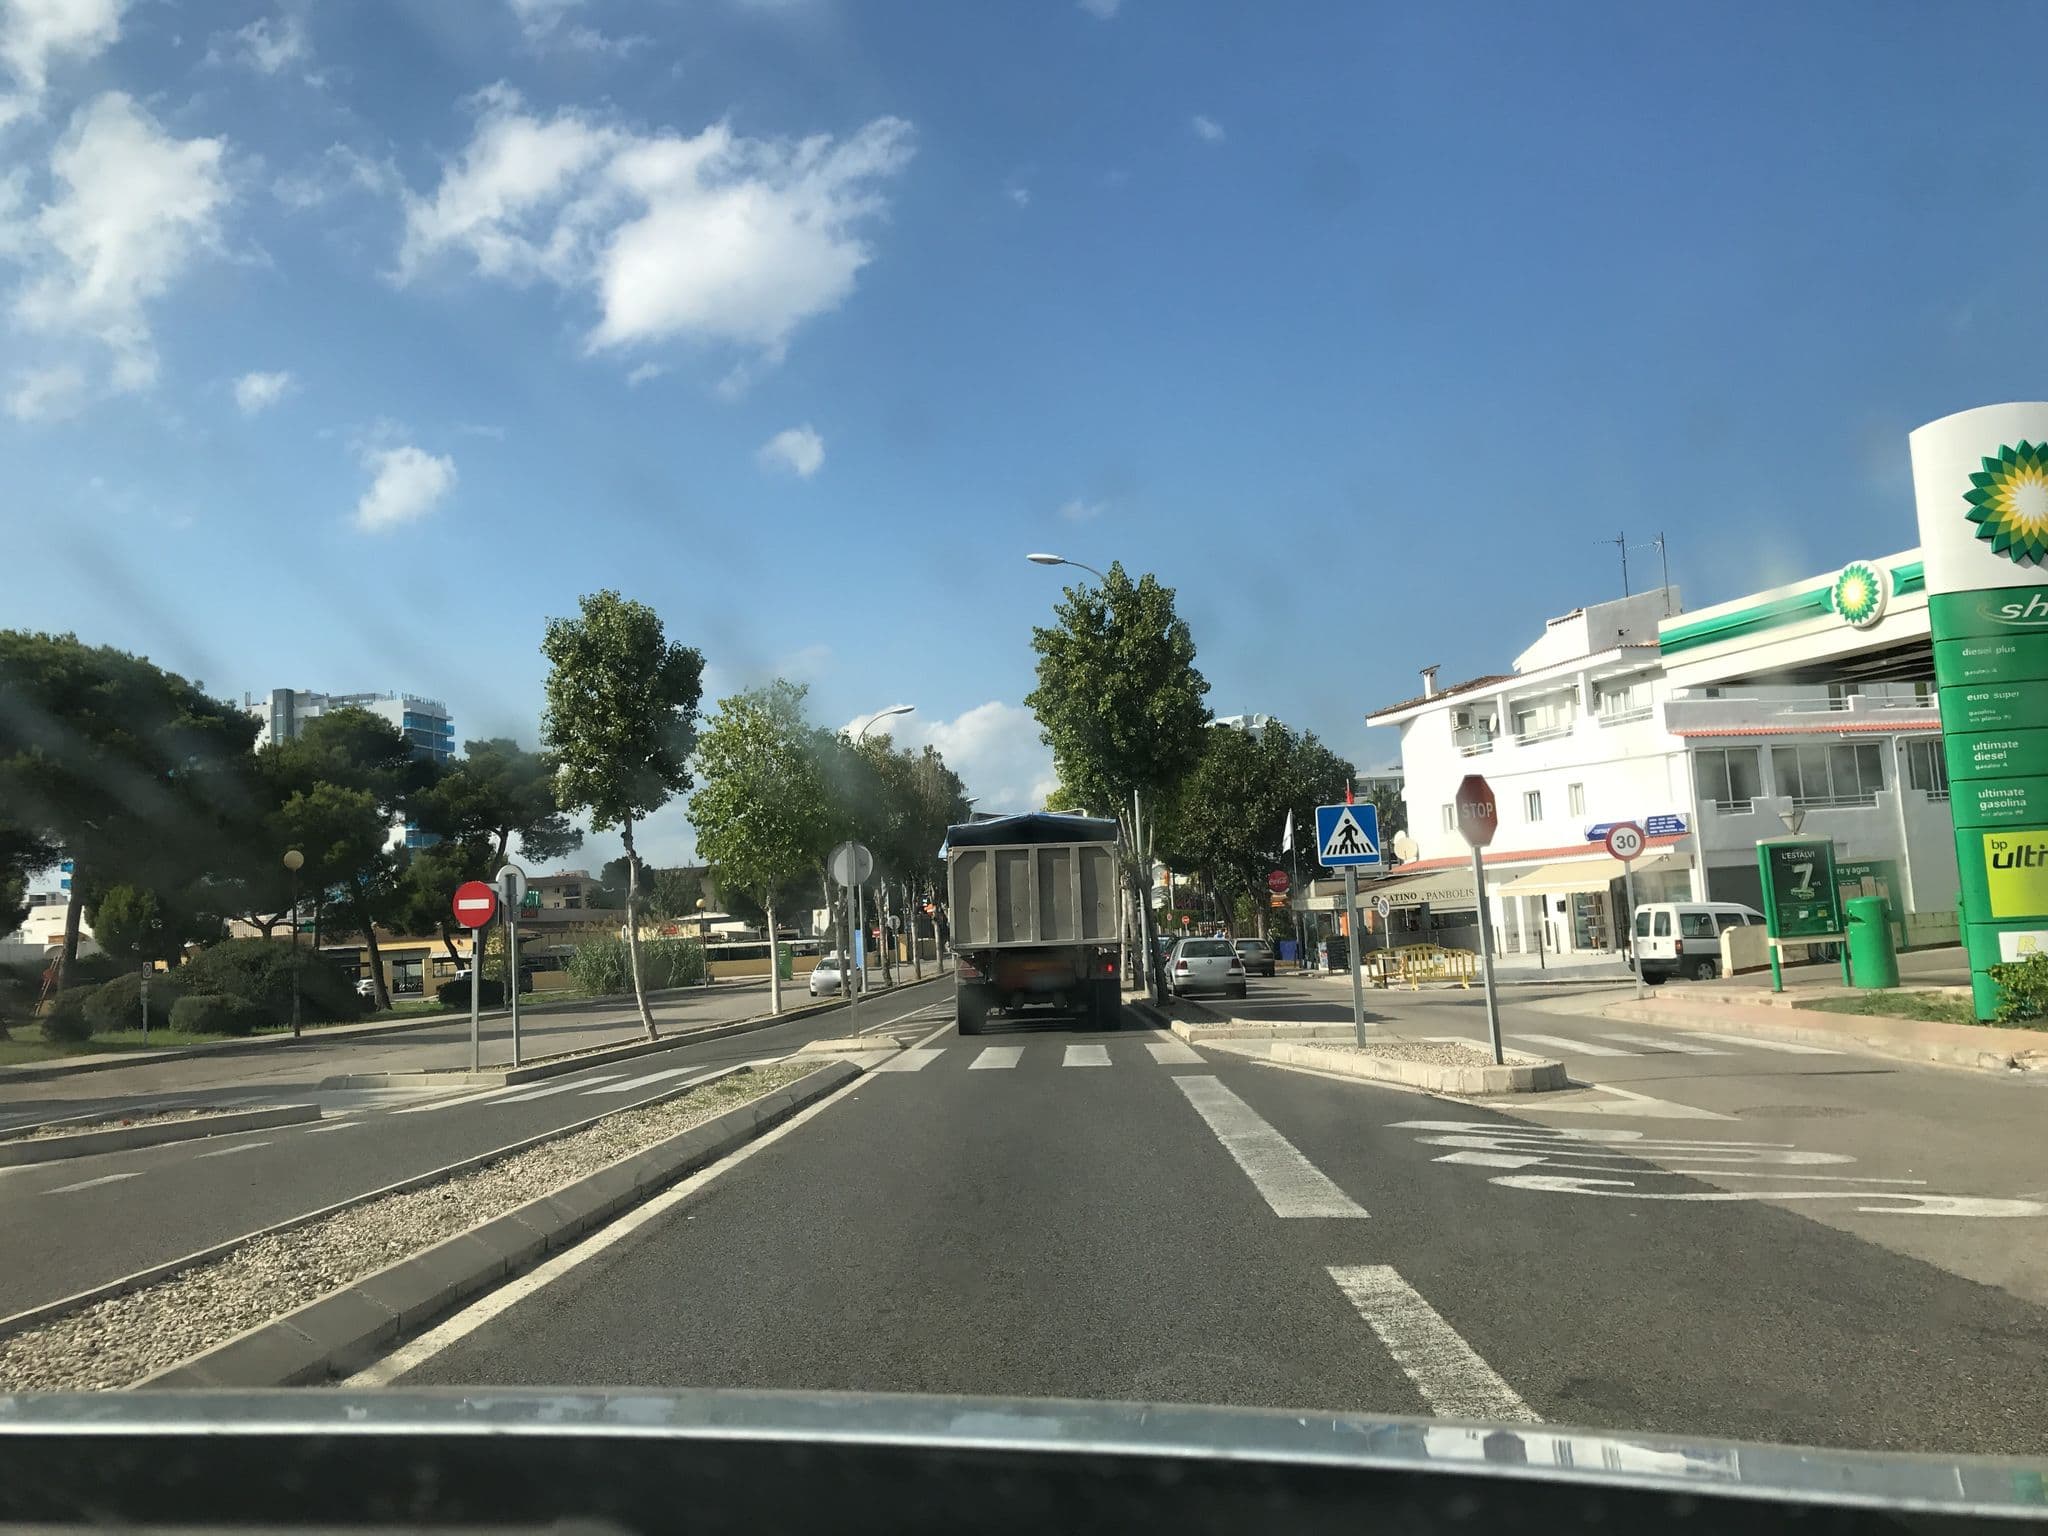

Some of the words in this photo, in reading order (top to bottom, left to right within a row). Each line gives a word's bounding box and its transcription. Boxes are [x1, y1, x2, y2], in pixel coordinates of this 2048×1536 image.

[2001, 594, 2048, 619] sh
[1962, 647, 1992, 656] diesel
[1996, 645, 2016, 656] plus
[1967, 693, 1989, 701] euro
[1993, 691, 2019, 700] super
[1972, 740, 2019, 751] ultimate
[1974, 751, 2007, 762] diesel
[1978, 788, 2025, 799] ultimate
[1462, 802, 1494, 818] STOP
[1979, 798, 2027, 811] gasolina
[1616, 834, 1637, 849] 30
[1991, 839, 2008, 852] bp
[1992, 844, 2048, 869] ulti
[1792, 863, 1814, 891] 7
[1845, 867, 1851, 876] y
[1851, 866, 1870, 876] agua
[1426, 888, 1475, 900] PANBOLIS
